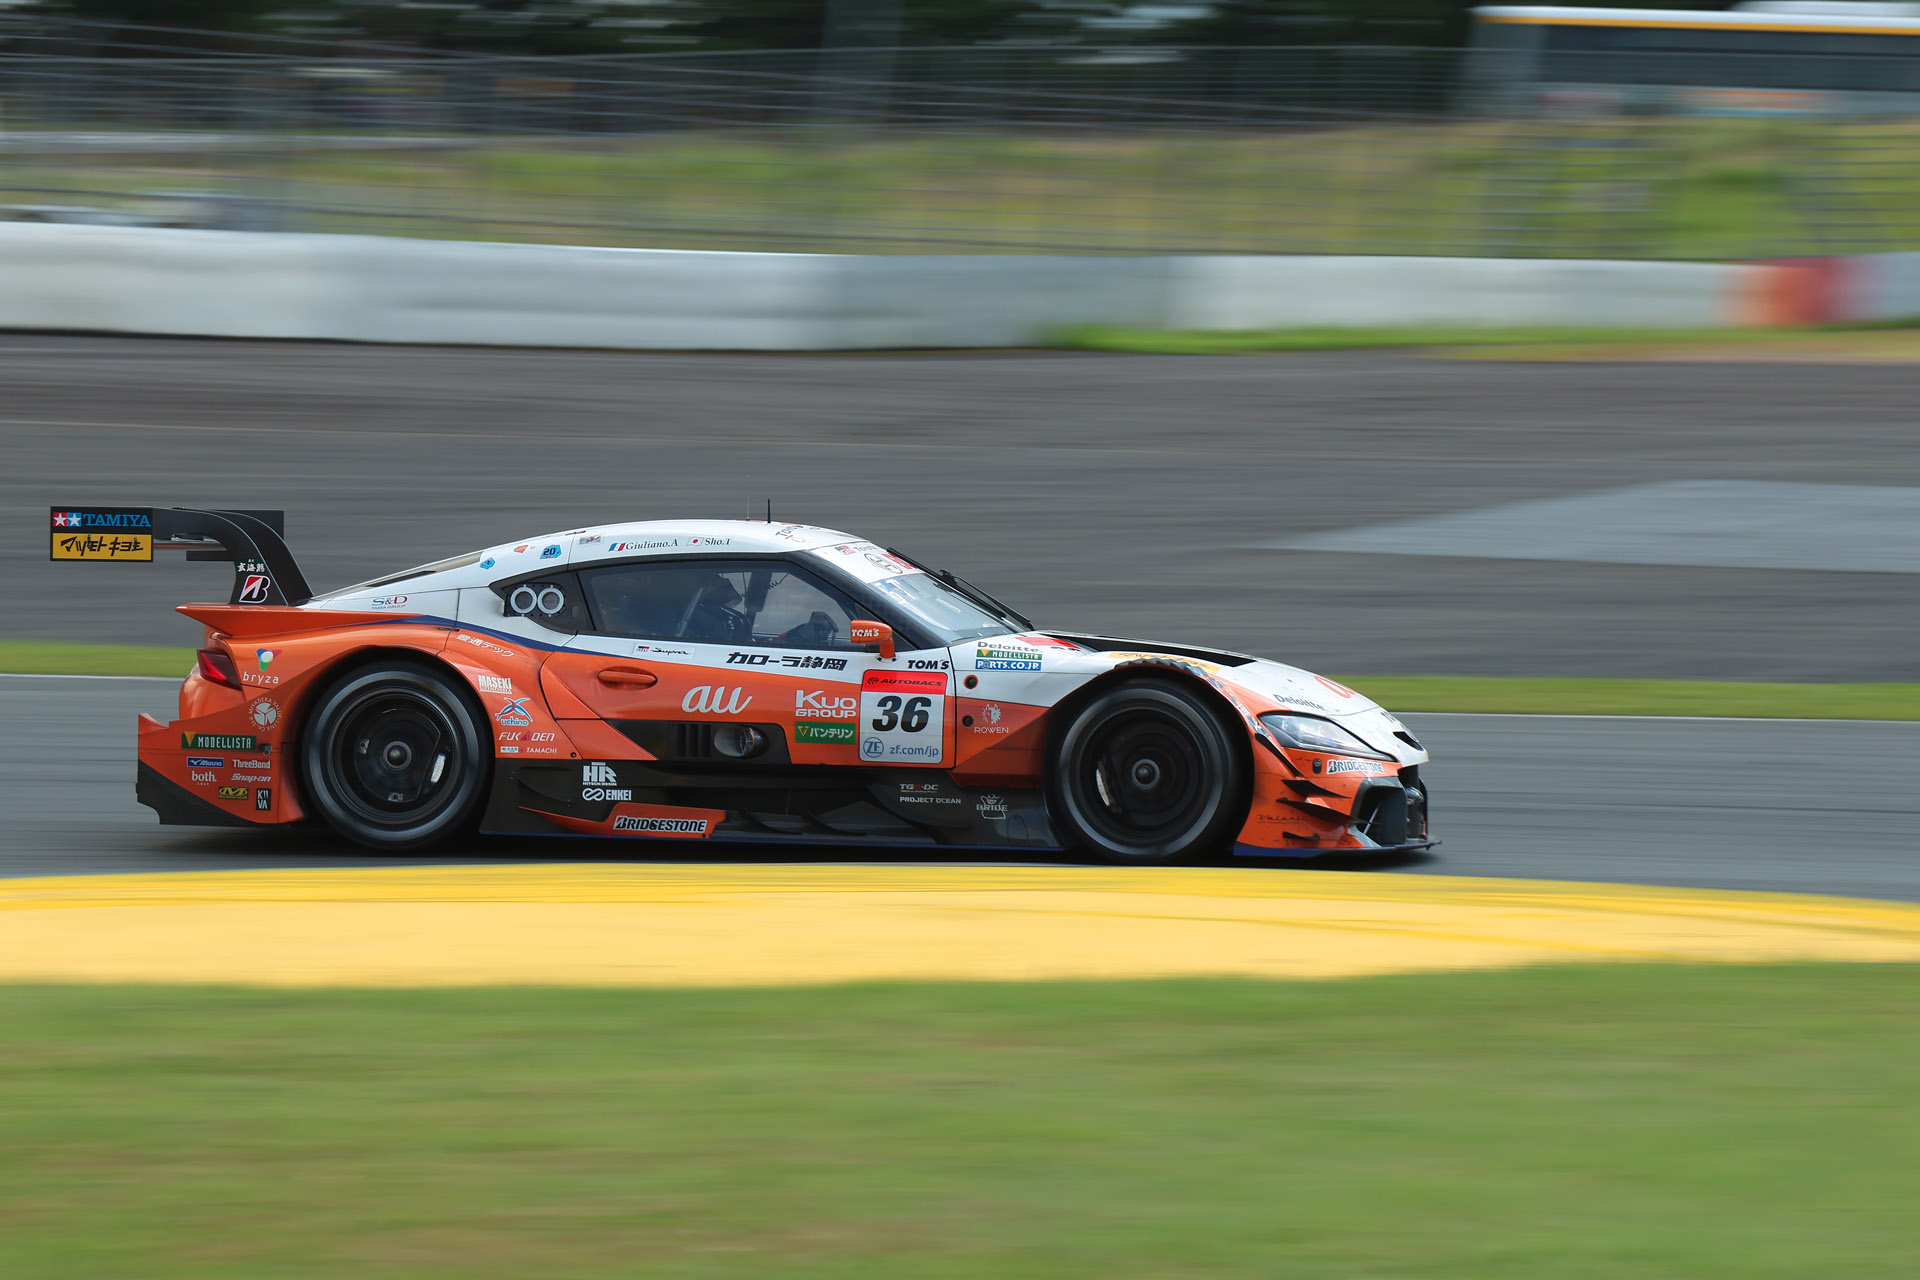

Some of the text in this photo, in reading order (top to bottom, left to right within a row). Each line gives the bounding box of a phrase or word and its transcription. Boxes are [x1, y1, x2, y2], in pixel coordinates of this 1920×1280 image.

[83, 513, 152, 528] TAMIYA
[625, 538, 679, 550] Giuliano.A
[543, 547, 557, 556] 20
[371, 595, 408, 606] S&D
[992, 650, 1039, 660] MODELLISTA
[725, 651, 849, 672] カローラ静岡
[907, 659, 950, 670] TOM'S
[242, 671, 280, 685] bryza
[477, 674, 513, 690] MASEKI
[880, 678, 944, 687] AUTOBACS
[681, 685, 754, 714] au
[795, 708, 857, 719] GROUP
[872, 695, 932, 733] 36
[501, 716, 528, 726] uchino
[809, 727, 854, 739] バンテリン
[974, 726, 1009, 734] ROWEN
[197, 735, 252, 749] MODELLISTA
[889, 744, 939, 758] zf.com/jp
[232, 759, 270, 769] ThreeBond
[1327, 758, 1384, 774] BRIDGESTONE
[231, 772, 271, 783] Snap-on
[605, 789, 632, 801] ENKEI
[976, 803, 1008, 812] BRIDE
[613, 815, 707, 833] BRIDGESTONE
